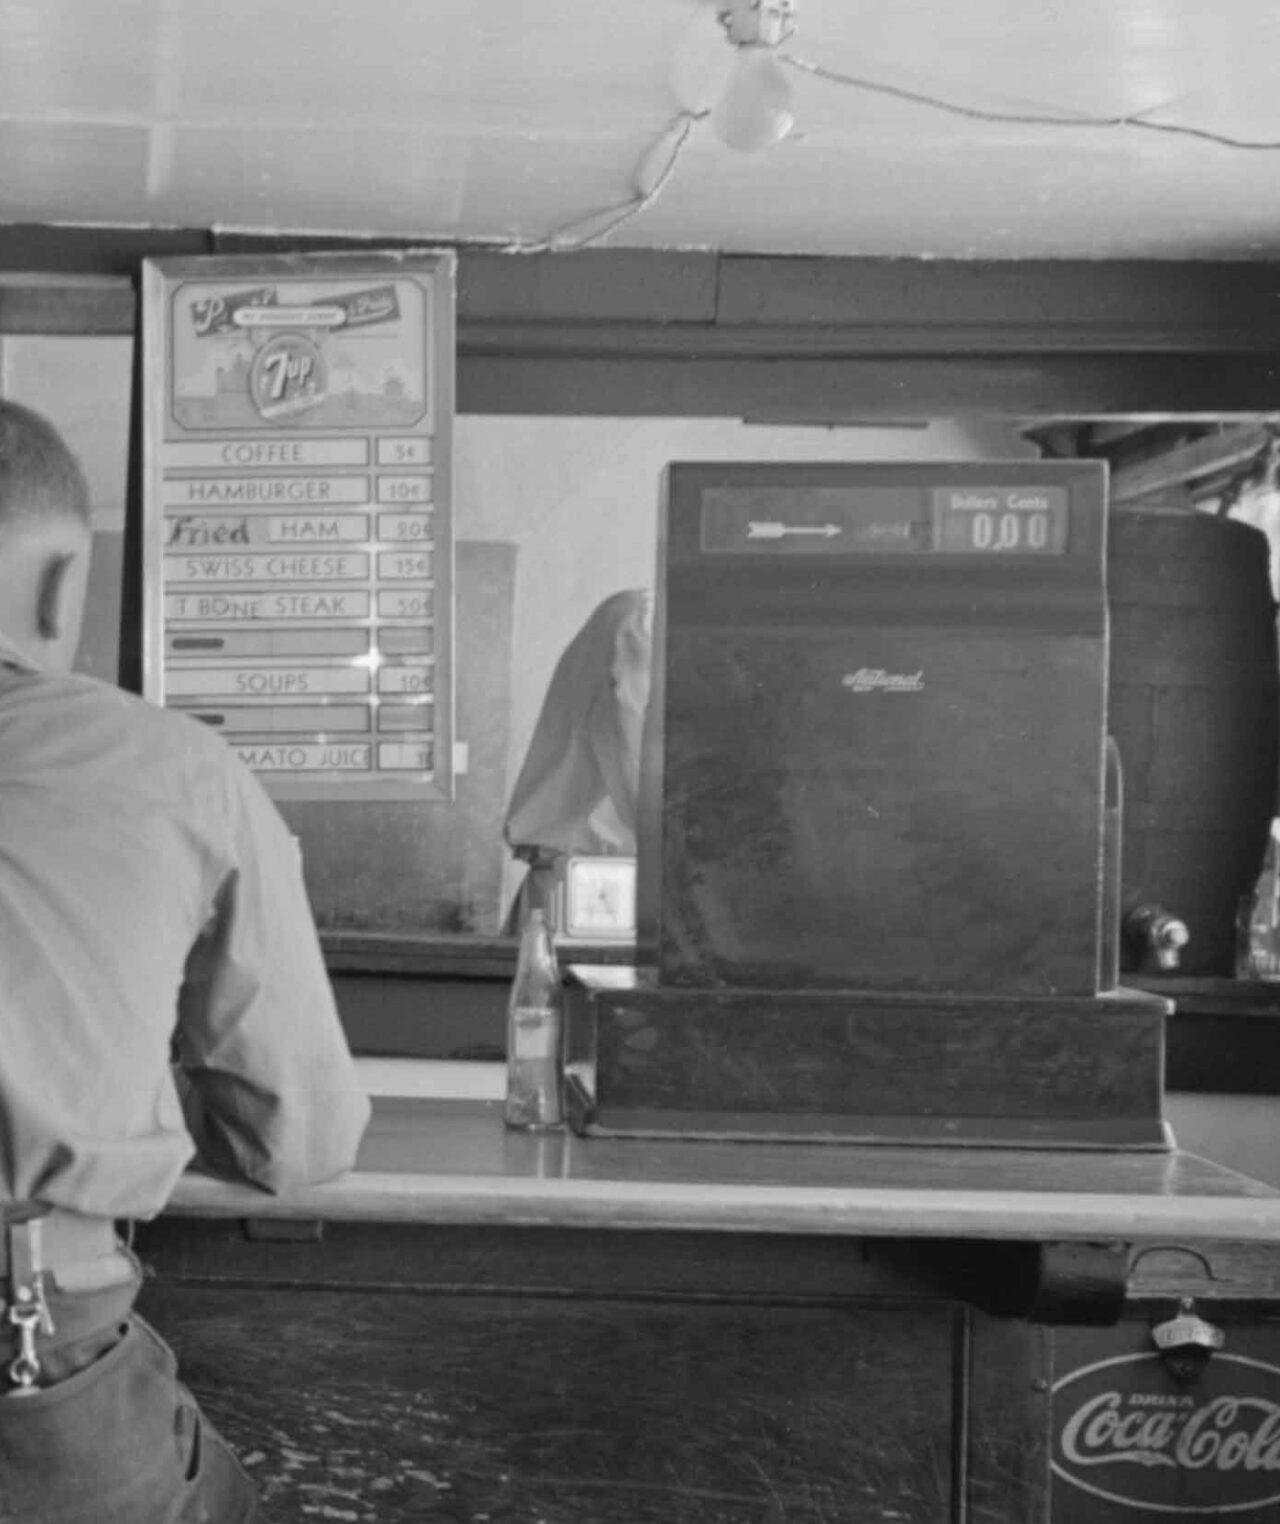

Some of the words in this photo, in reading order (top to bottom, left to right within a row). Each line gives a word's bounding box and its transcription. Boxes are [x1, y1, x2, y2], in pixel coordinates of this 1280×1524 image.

[221, 443, 304, 463] COFFEE
[396, 443, 417, 460] 5¢
[188, 482, 330, 500] HAMBURGER
[389, 483, 421, 498] 10¢
[170, 515, 251, 545] Fried
[281, 520, 340, 538] HAM
[185, 558, 255, 577] SWISS
[267, 557, 347, 576] CHEESE
[199, 598, 259, 619] BONE
[276, 596, 346, 615] STEAK
[235, 673, 309, 691] SOUPS
[238, 748, 307, 767] MATO
